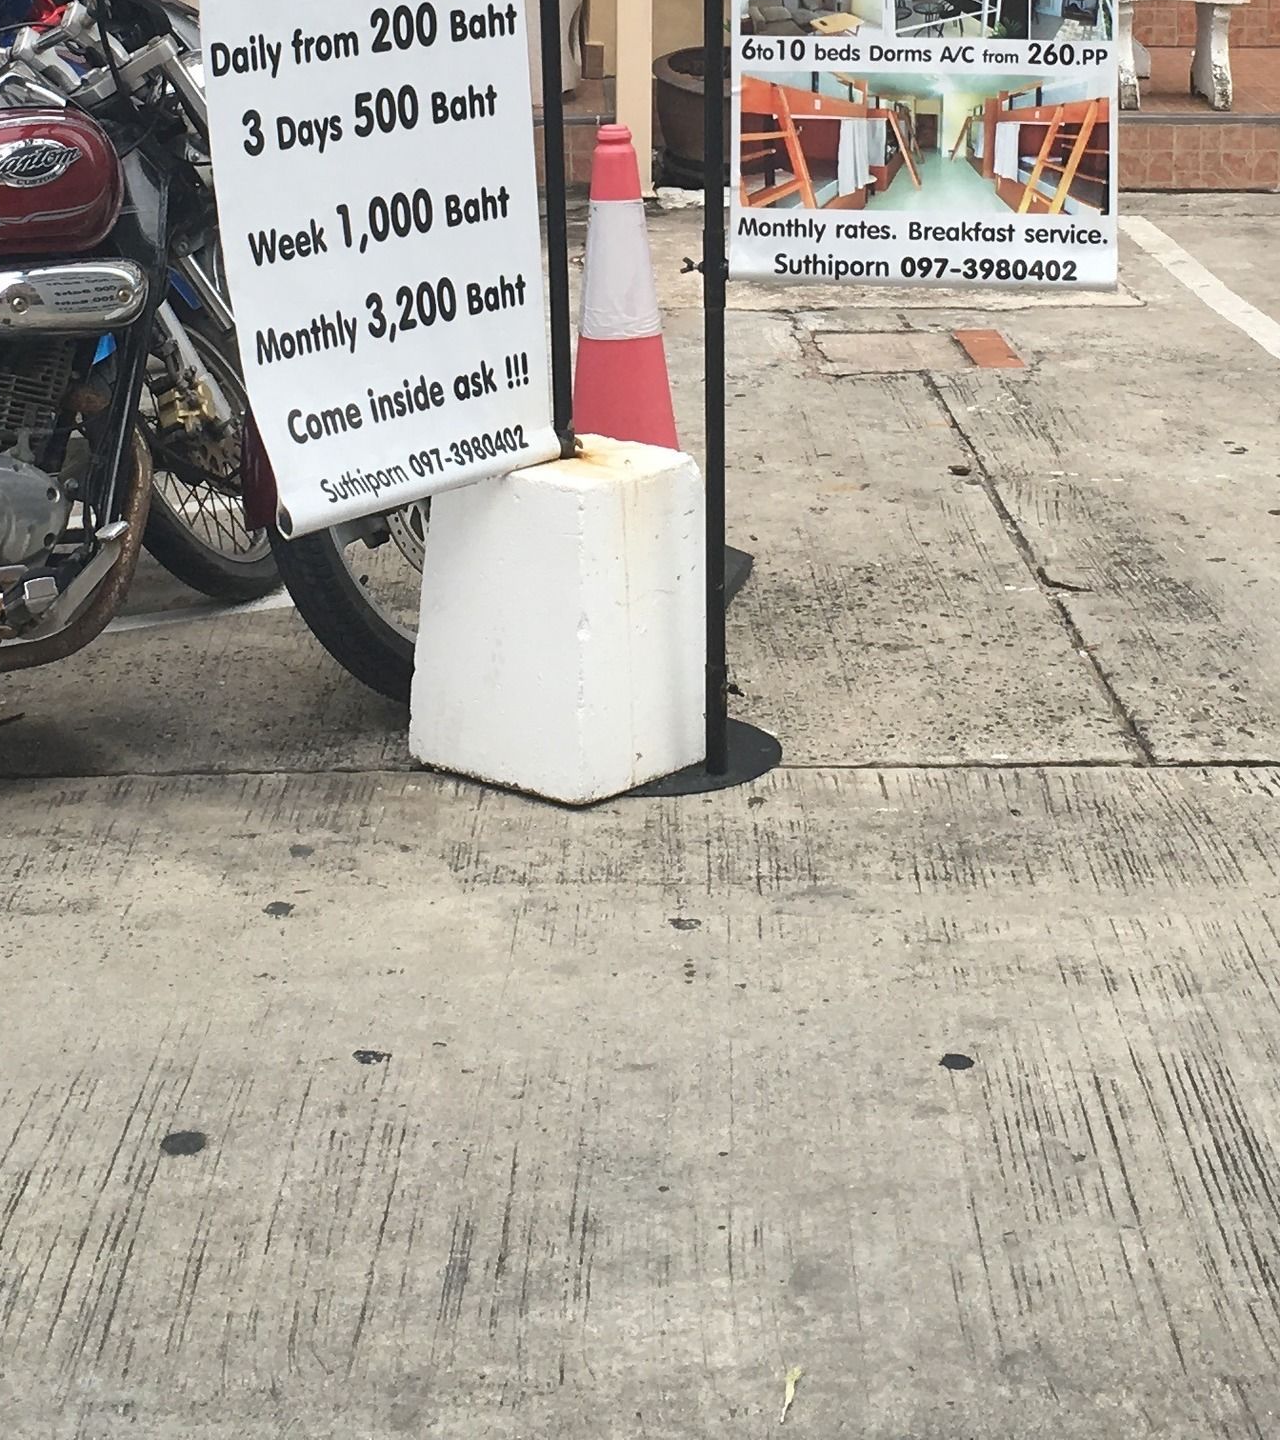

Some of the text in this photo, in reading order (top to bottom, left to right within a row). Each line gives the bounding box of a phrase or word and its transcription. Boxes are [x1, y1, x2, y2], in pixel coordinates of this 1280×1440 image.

[210, 1, 518, 79] Daily from 200 Baht
[814, 42, 861, 62] beds
[869, 45, 932, 63] Dorms
[939, 45, 975, 64] A/C
[982, 48, 1019, 64] from
[241, 83, 498, 157] 3 Days 500 Baht
[247, 185, 510, 267] Week 1,000 Baht
[737, 216, 1108, 245] Monthly rates. Breakfast service.
[773, 252, 1078, 282] Suthiporn 097-3980402
[255, 273, 527, 366] Monthly 3,200 Baht
[287, 351, 530, 445] Come inside ask !!!
[320, 424, 529, 504] Suthiporn 097-3980402
